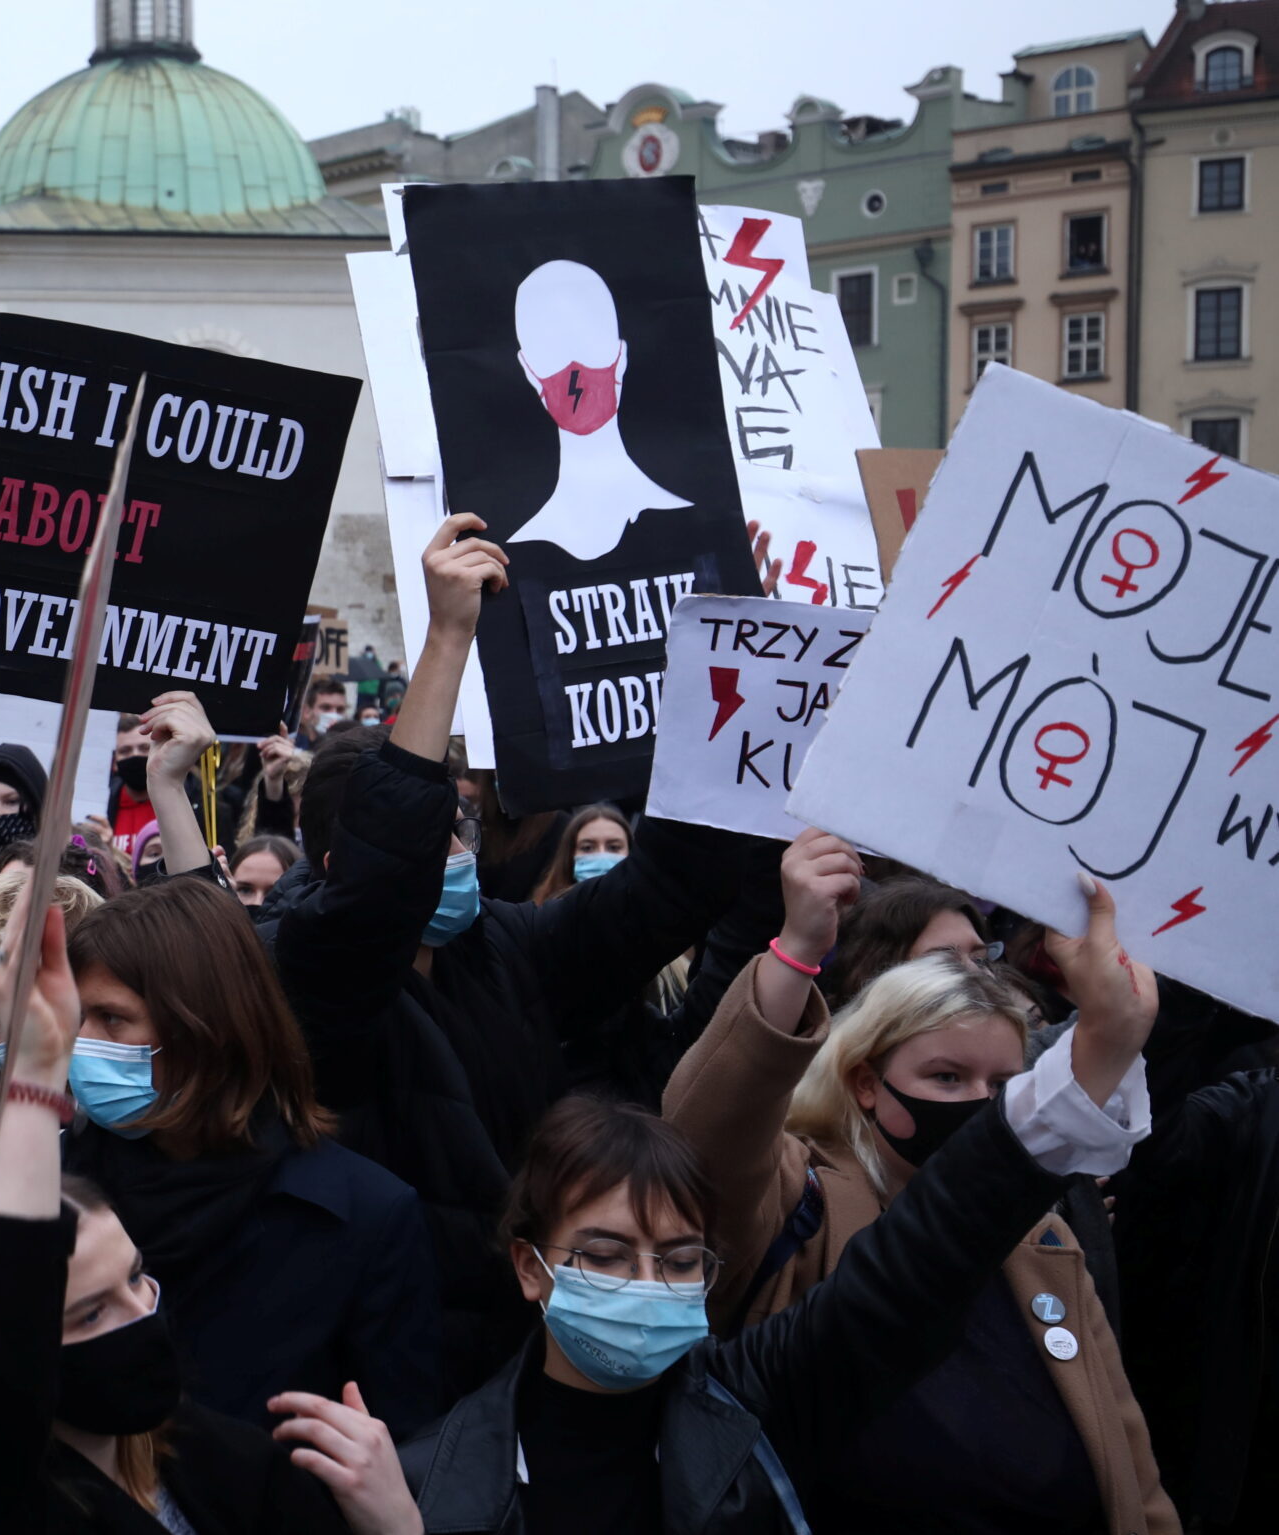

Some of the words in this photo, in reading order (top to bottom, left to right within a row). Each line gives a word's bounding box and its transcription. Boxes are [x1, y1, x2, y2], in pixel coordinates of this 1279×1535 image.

[94, 382, 127, 448] I
[145, 392, 305, 481] COULD
[700, 617, 819, 663] TRZY
[907, 637, 1207, 881] MÓJ
